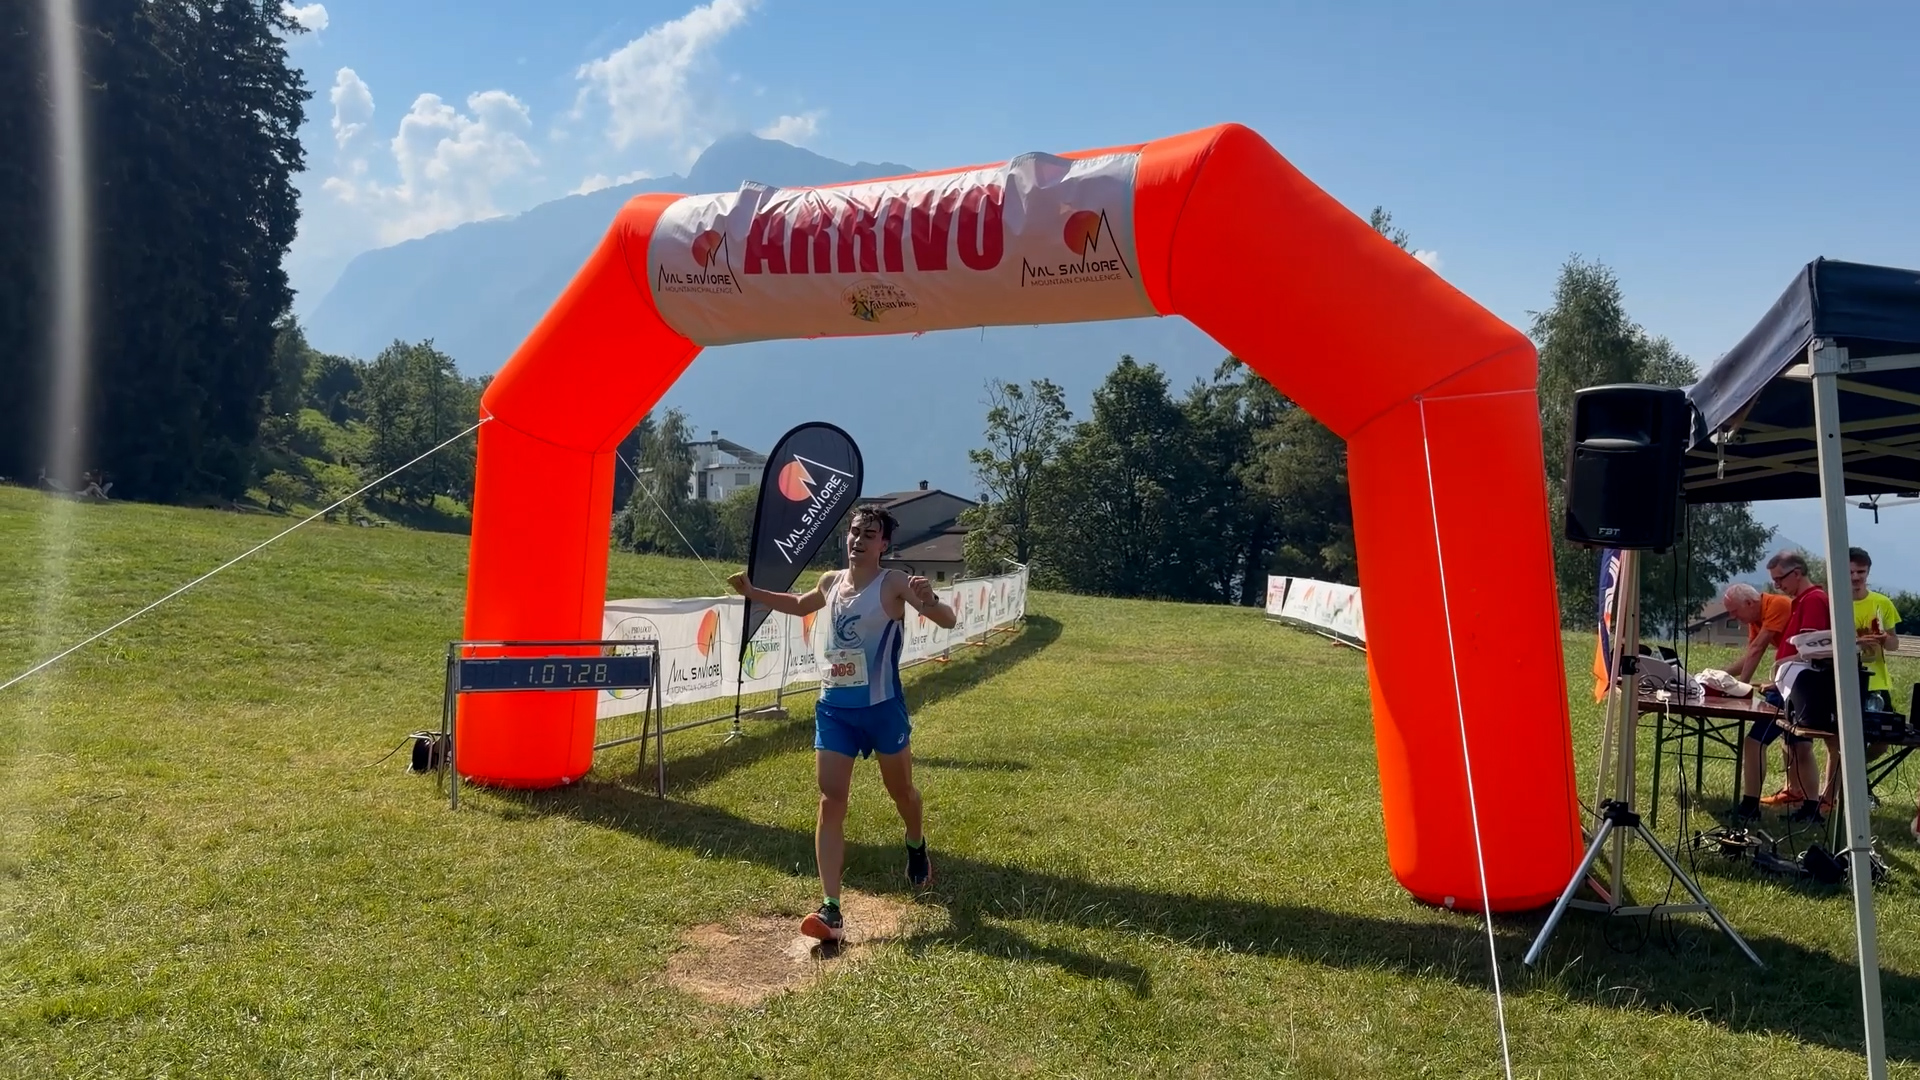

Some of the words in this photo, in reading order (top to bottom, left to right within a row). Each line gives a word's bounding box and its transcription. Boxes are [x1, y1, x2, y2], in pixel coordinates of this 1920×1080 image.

[744, 184, 1004, 274] ARRIVO
[1059, 259, 1119, 276] SAVIORE
[686, 273, 731, 285] SAVIORE
[1031, 277, 1073, 287] MOUNTAIN
[1073, 273, 1121, 283] CHALLENGE
[697, 286, 733, 294] CHALLENGE
[801, 474, 841, 525] SAVIORE
[793, 520, 821, 556] MOUNTAIN
[819, 481, 849, 521] CHALLENGE
[691, 664, 720, 680] SAVIORE
